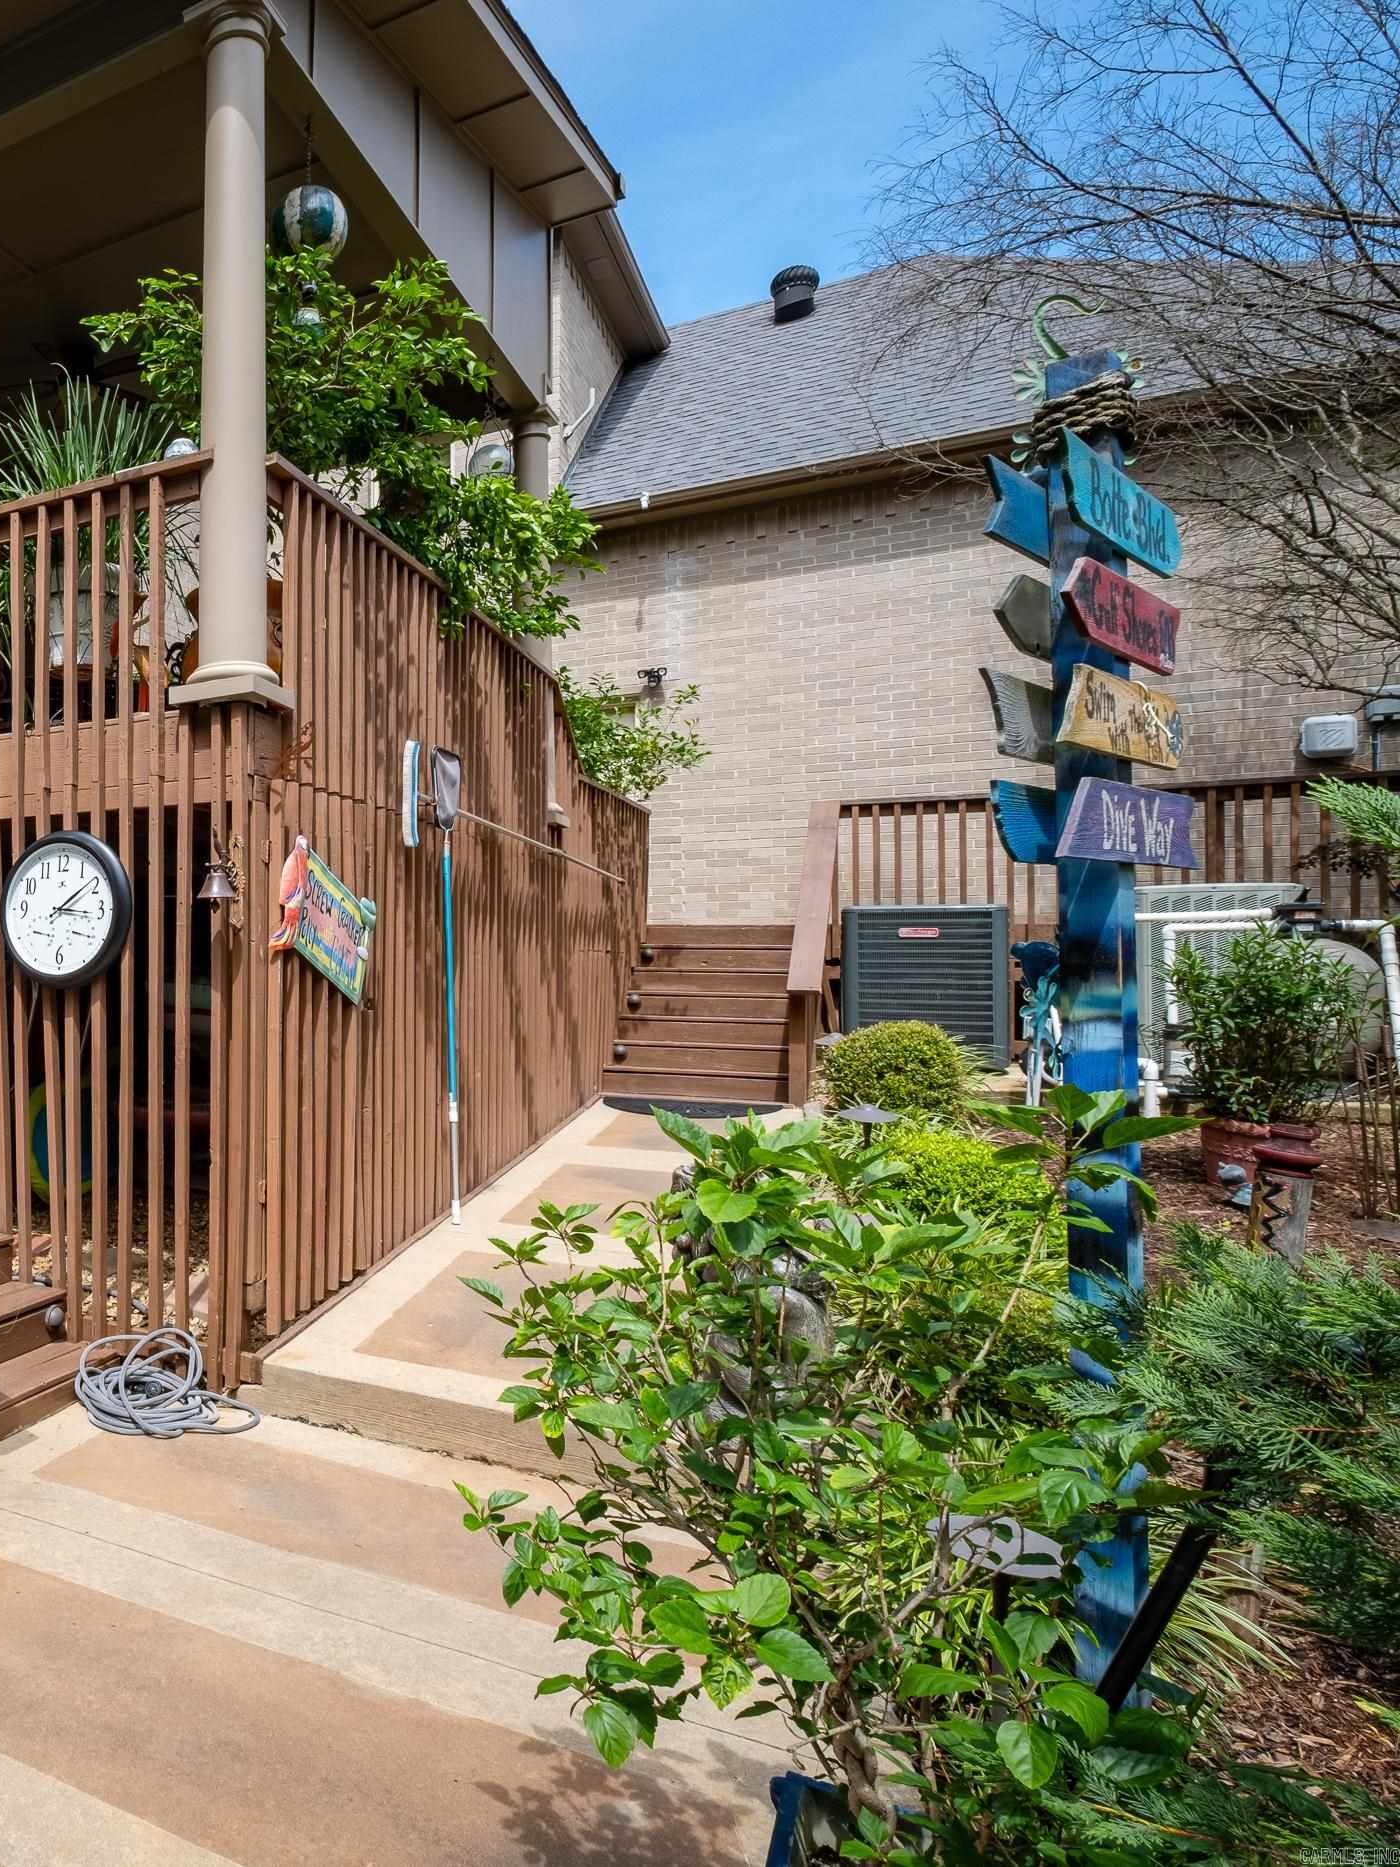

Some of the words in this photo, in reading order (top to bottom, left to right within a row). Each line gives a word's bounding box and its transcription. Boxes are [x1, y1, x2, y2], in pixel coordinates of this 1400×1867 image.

[1132, 492, 1171, 565] Blvd.
[1140, 796, 1175, 865] Way
[40, 862, 50, 880] 11
[57, 854, 70, 873] 12
[79, 861, 85, 879] 1
[25, 877, 37, 896] 10
[91, 876, 100, 895] 2
[20, 900, 29, 919] 9
[97, 900, 105, 920] 3
[55, 944, 64, 965] 6
